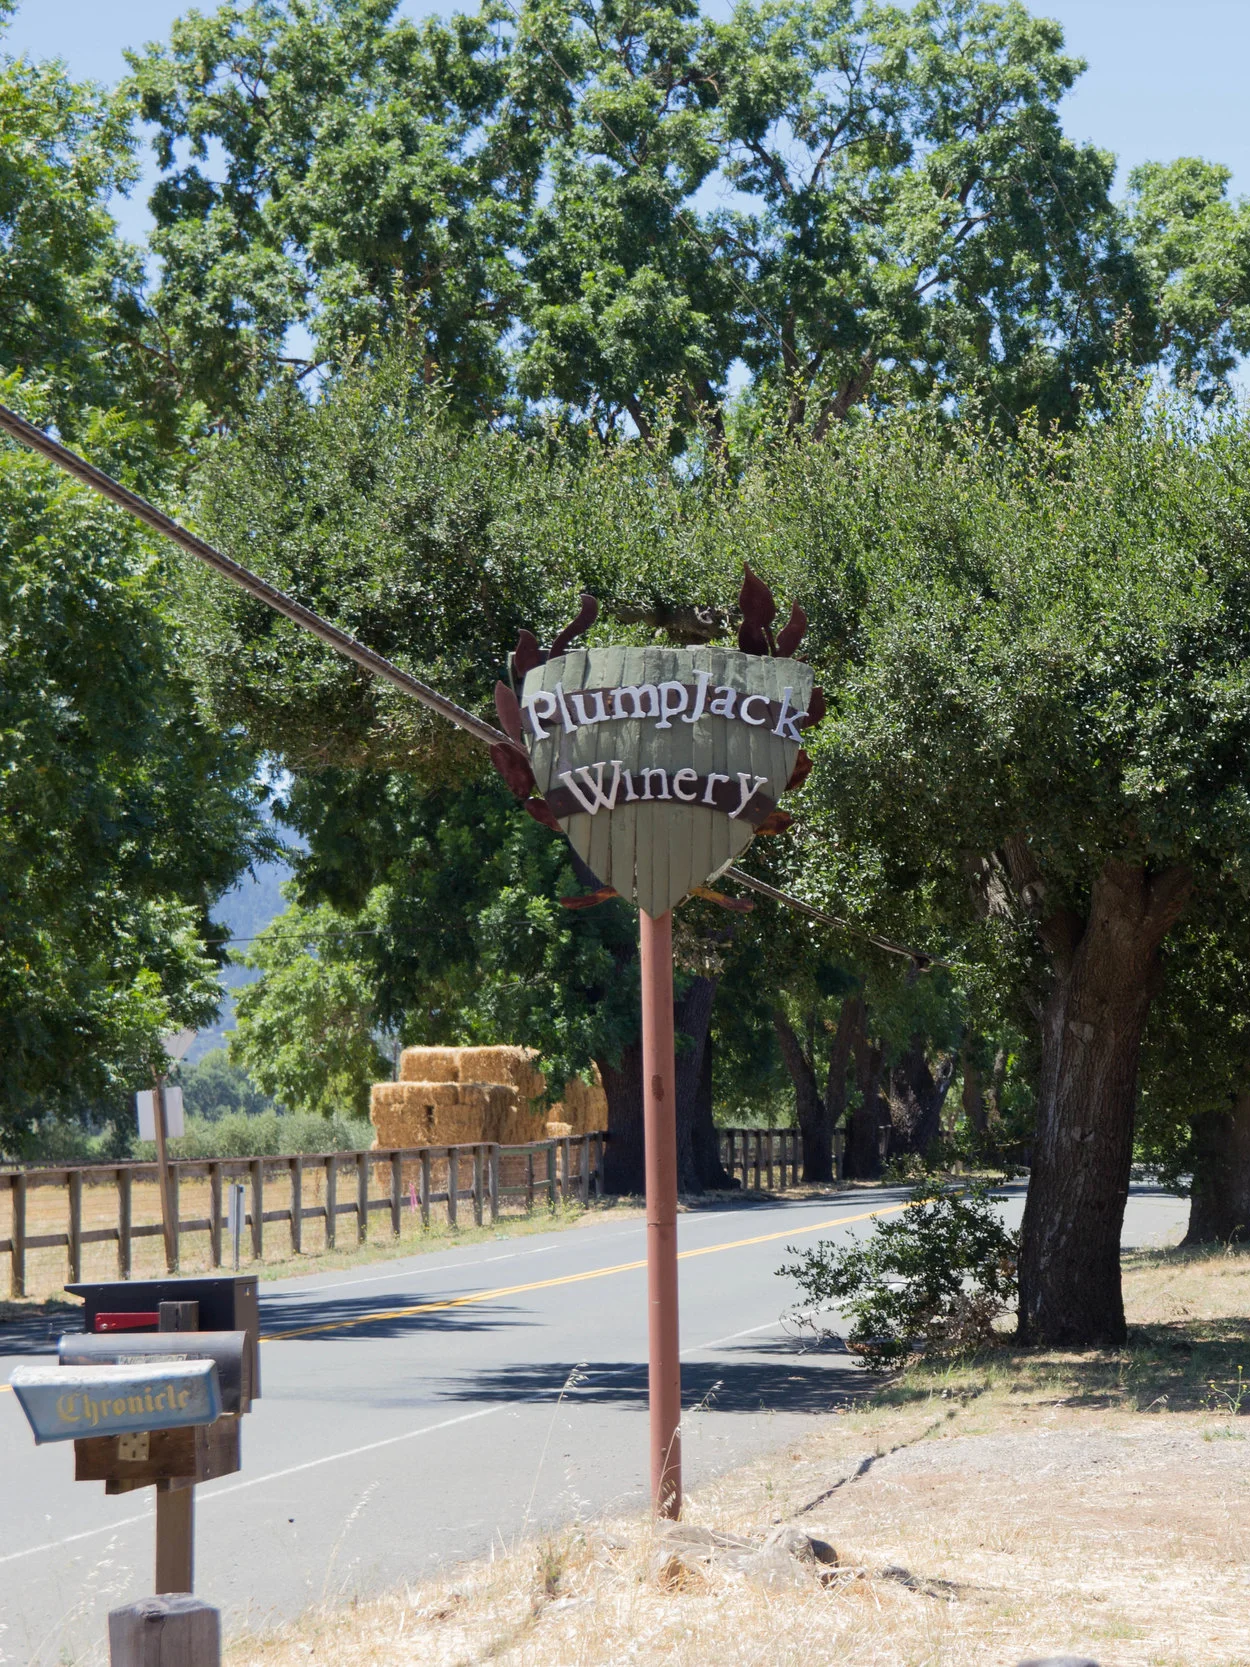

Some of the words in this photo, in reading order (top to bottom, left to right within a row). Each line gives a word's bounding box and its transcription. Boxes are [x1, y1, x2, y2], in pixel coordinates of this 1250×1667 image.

[522, 670, 809, 743] PlumpJack
[559, 760, 768, 819] Winery
[57, 1385, 190, 1426] Chronicle
